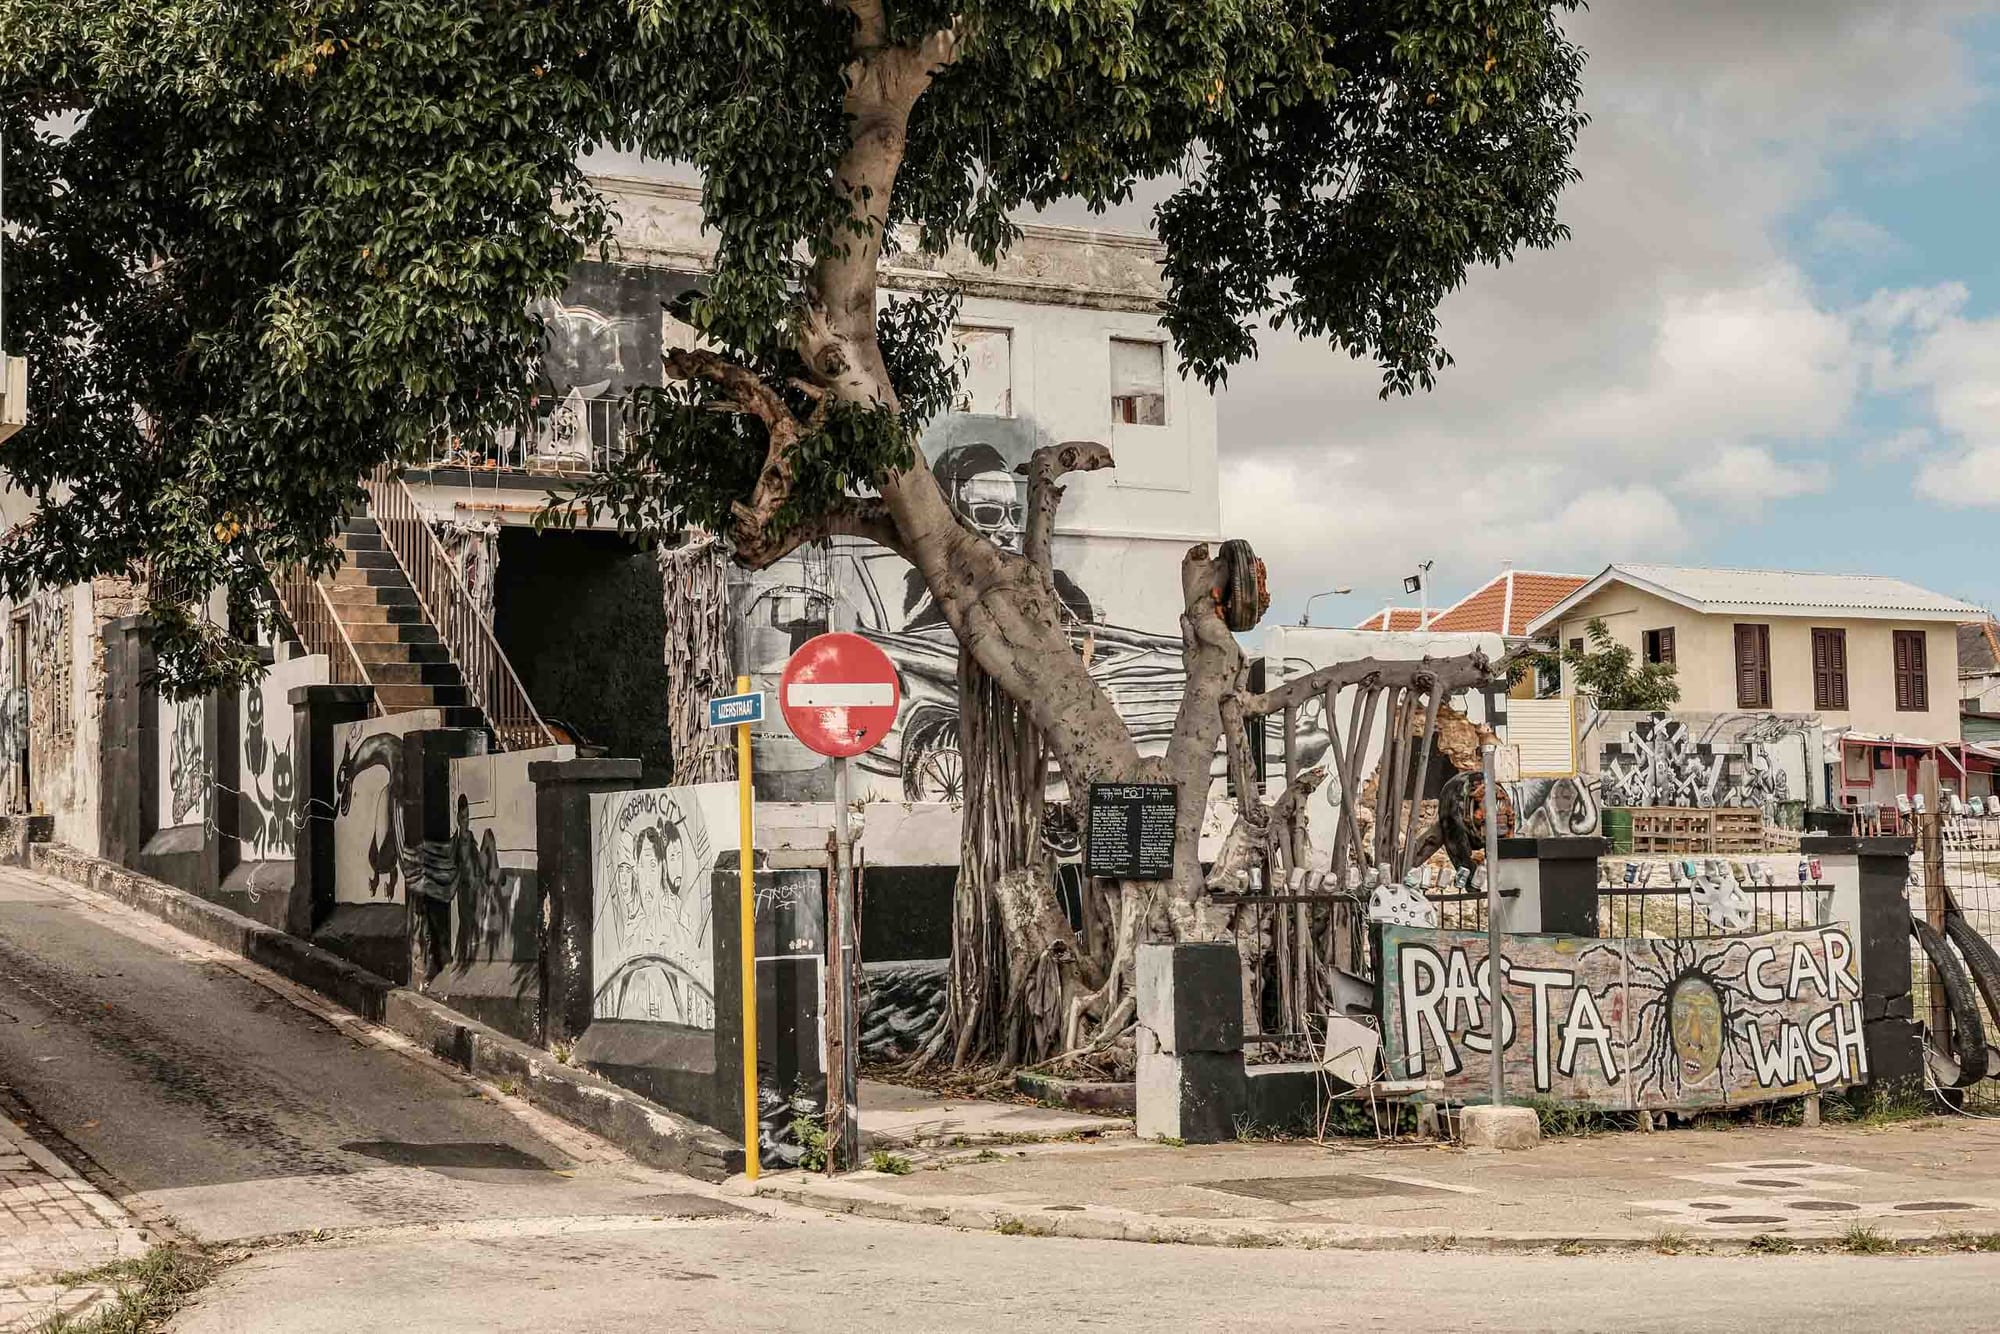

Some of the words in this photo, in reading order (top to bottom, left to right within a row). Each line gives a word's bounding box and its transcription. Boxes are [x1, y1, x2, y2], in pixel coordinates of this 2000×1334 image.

[658, 793, 687, 825] CITY
[1745, 928, 1861, 1004] CAR
[1398, 943, 1620, 1092] RASTA
[1746, 999, 1868, 1087] WASH
